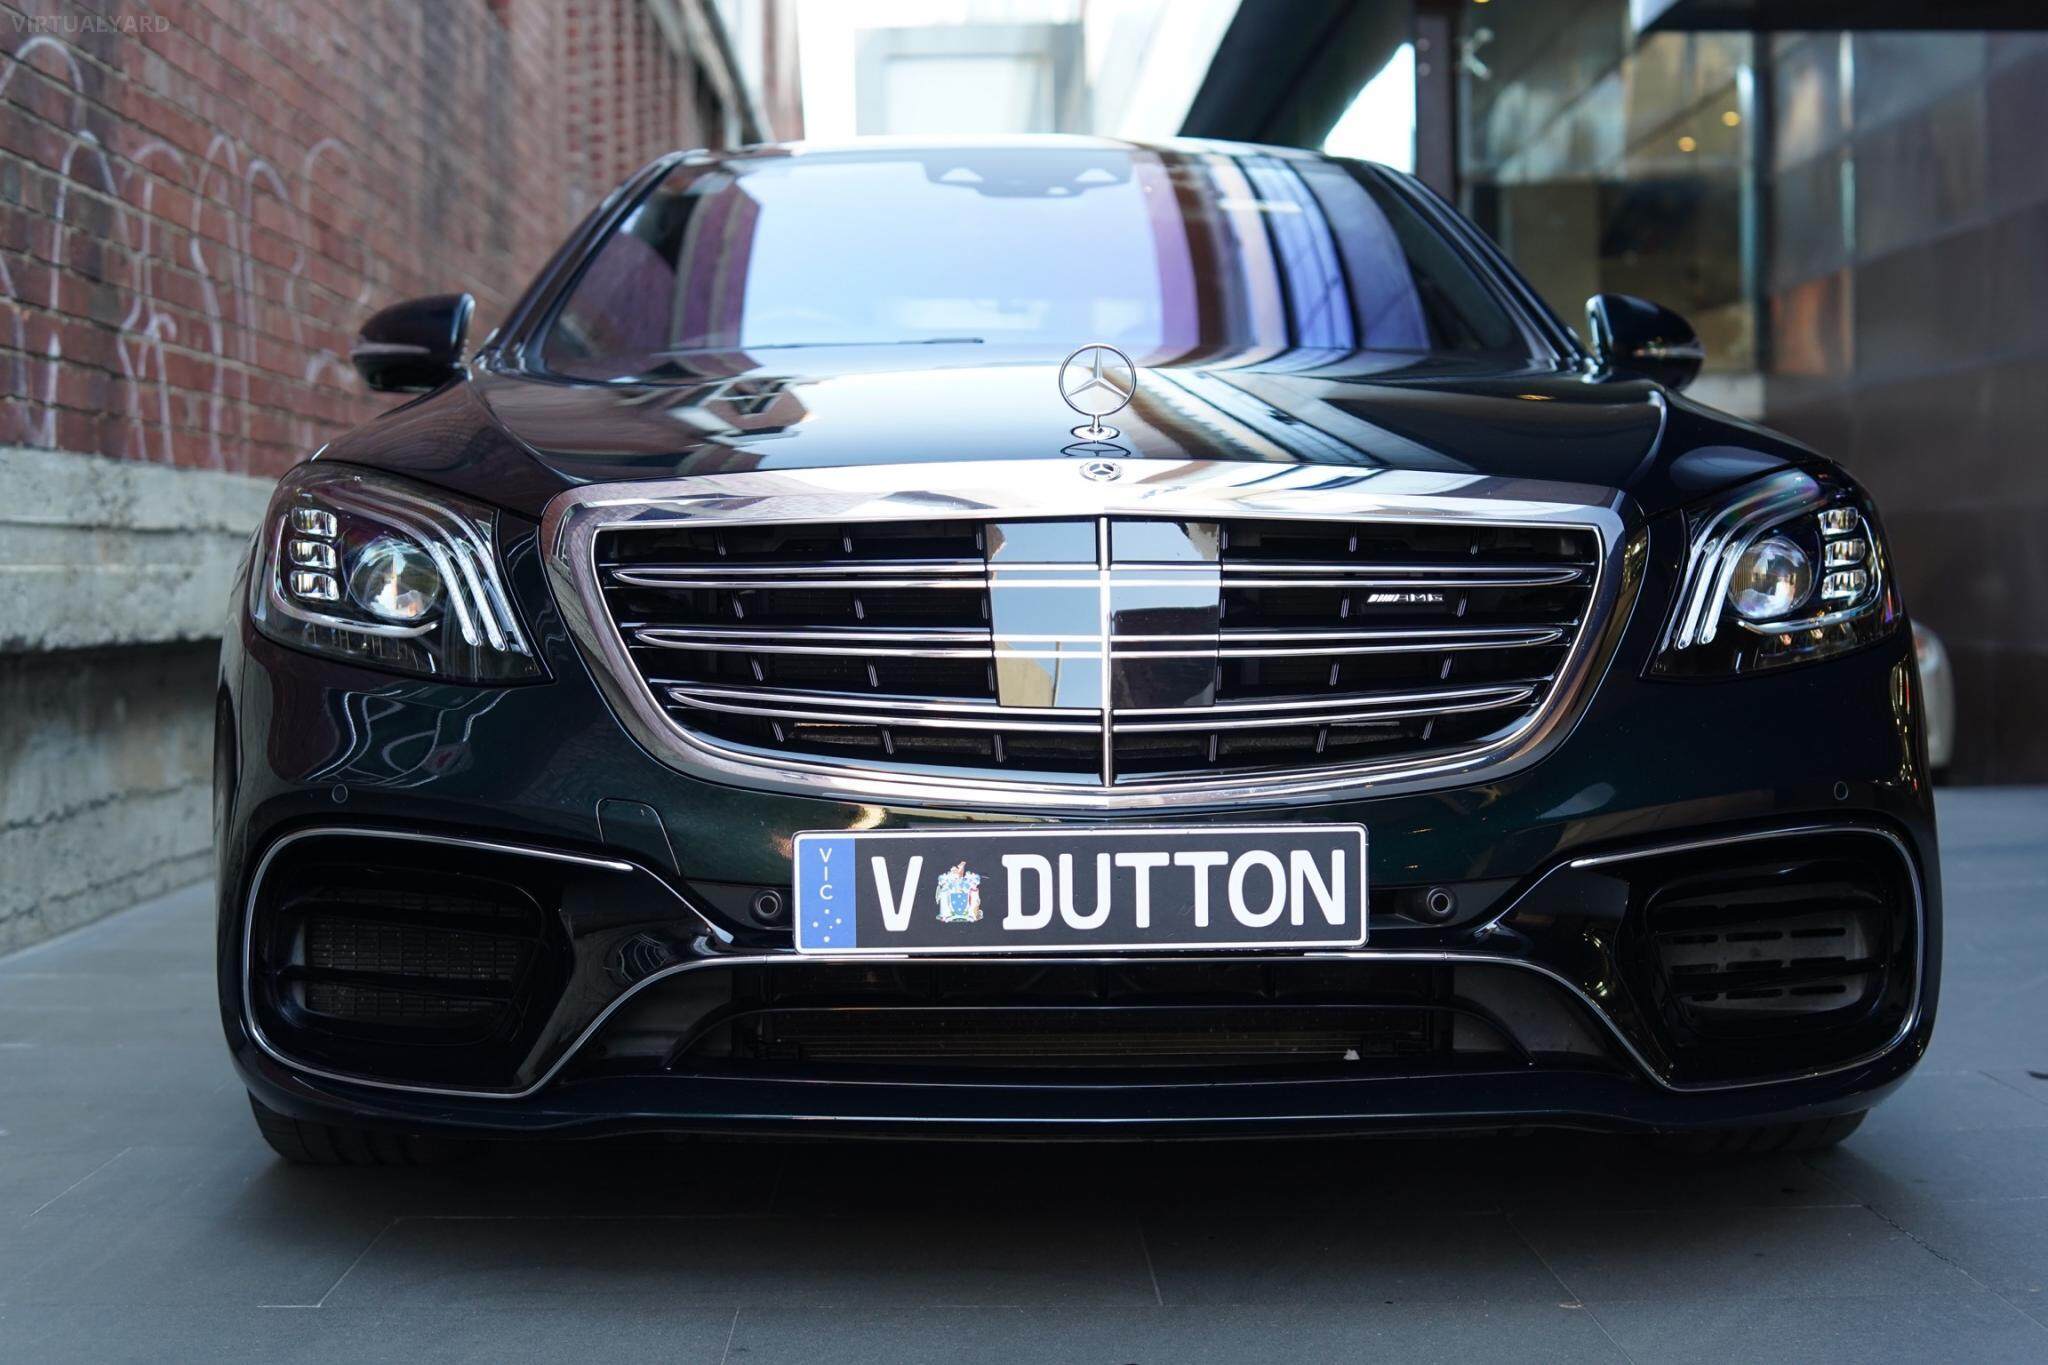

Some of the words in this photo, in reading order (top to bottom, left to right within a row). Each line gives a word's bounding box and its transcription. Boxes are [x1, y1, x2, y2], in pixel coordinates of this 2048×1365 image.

[818, 847, 834, 900] VIC
[871, 856, 923, 932] V
[1002, 849, 1346, 930] DUTTON
